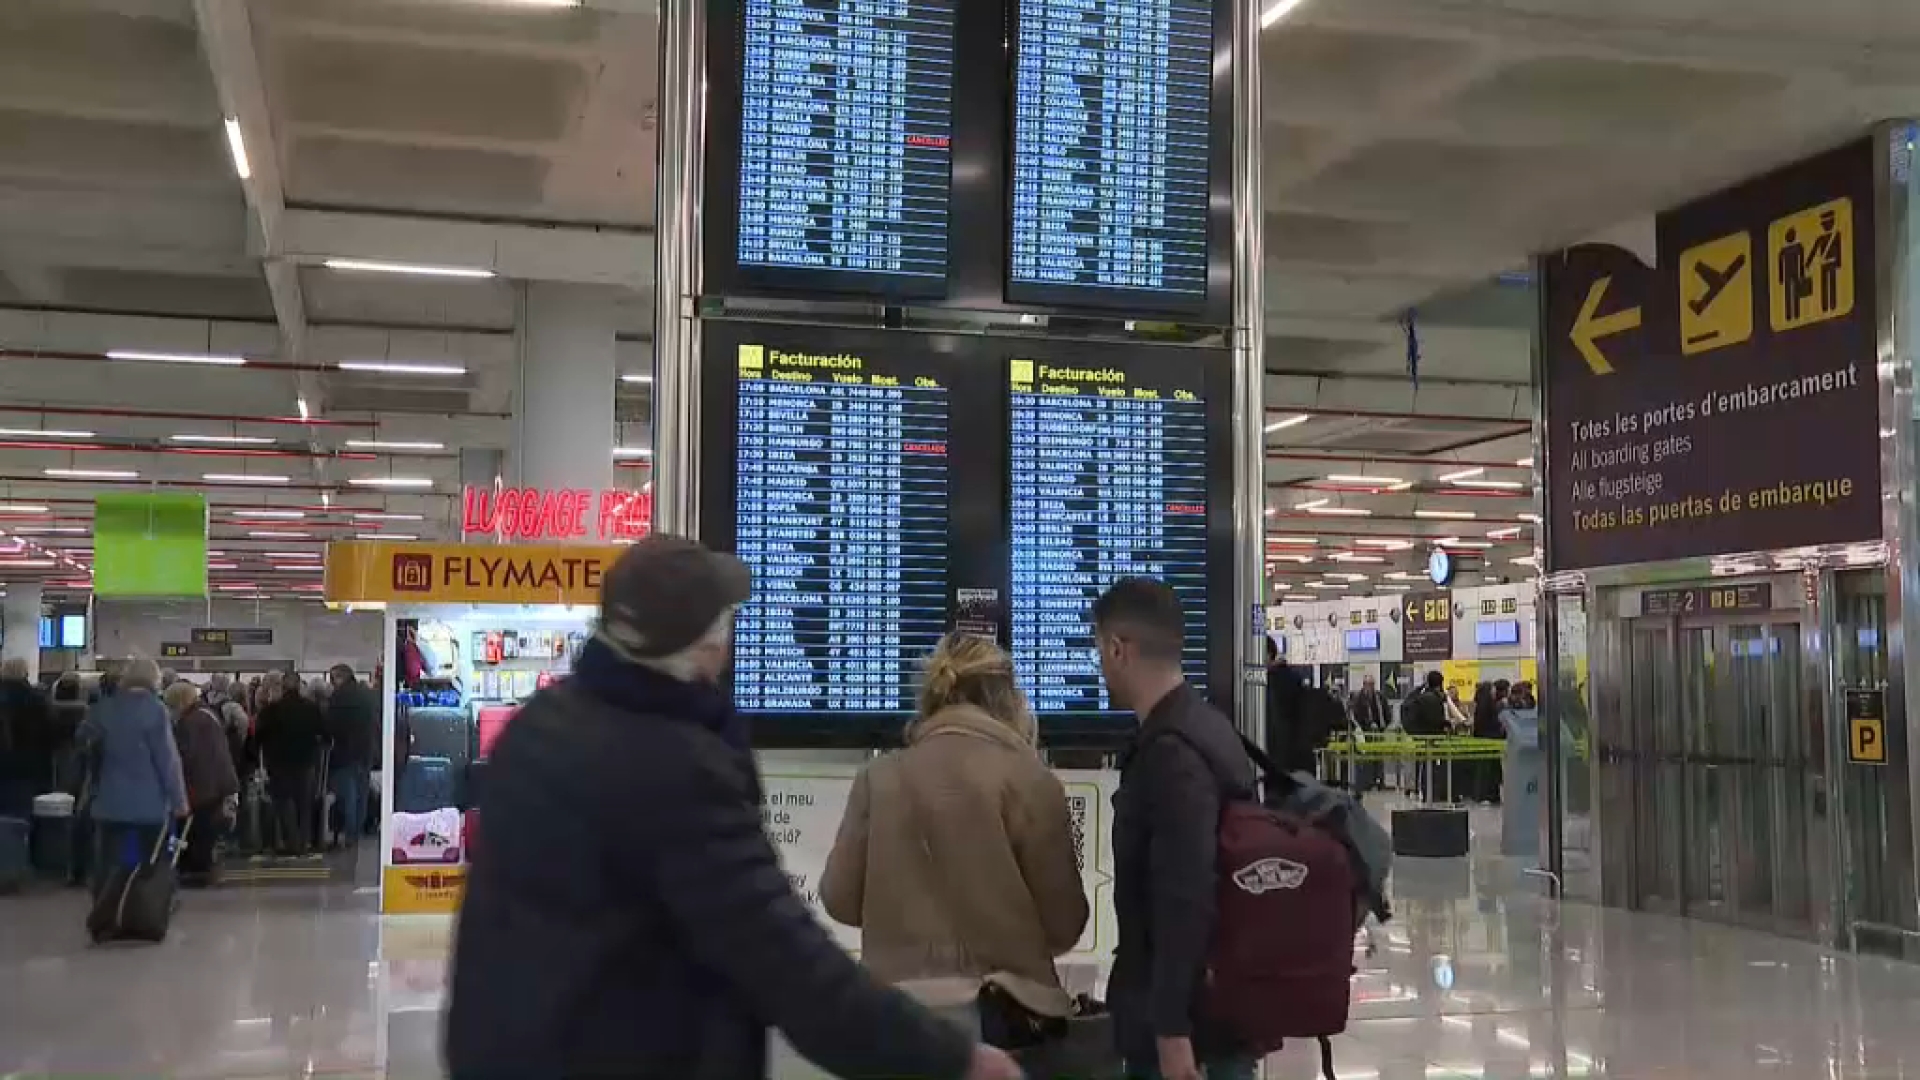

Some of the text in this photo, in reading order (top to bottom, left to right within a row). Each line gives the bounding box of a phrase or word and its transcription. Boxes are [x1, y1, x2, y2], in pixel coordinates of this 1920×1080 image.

[772, 137, 828, 149] BARCELONA
[769, 253, 825, 265] BARCELONA
[770, 350, 862, 369] Facturación
[1039, 365, 1125, 383] Facturación
[769, 384, 826, 395] BARCELONA
[769, 397, 816, 408] MENORCA
[1039, 397, 1092, 408] BARCELONA
[1571, 362, 1857, 442] Totes les portes d'embarcament
[769, 450, 796, 460] IBIZA
[1571, 434, 1692, 472] All boarding gates
[767, 477, 807, 487] MADRID
[1571, 471, 1663, 502] Alle flugsteige
[767, 490, 815, 500] MENORCA
[1572, 476, 1853, 532] Todas las puertas de embarque
[464, 486, 592, 538] LUGGAGE
[767, 516, 823, 526] FRANKFURT
[765, 594, 823, 604] BARCELONA
[1684, 590, 1694, 611] 2
[1859, 726, 1876, 753] P
[771, 791, 782, 805] el
[786, 793, 815, 806] meu
[774, 809, 791, 824] de
